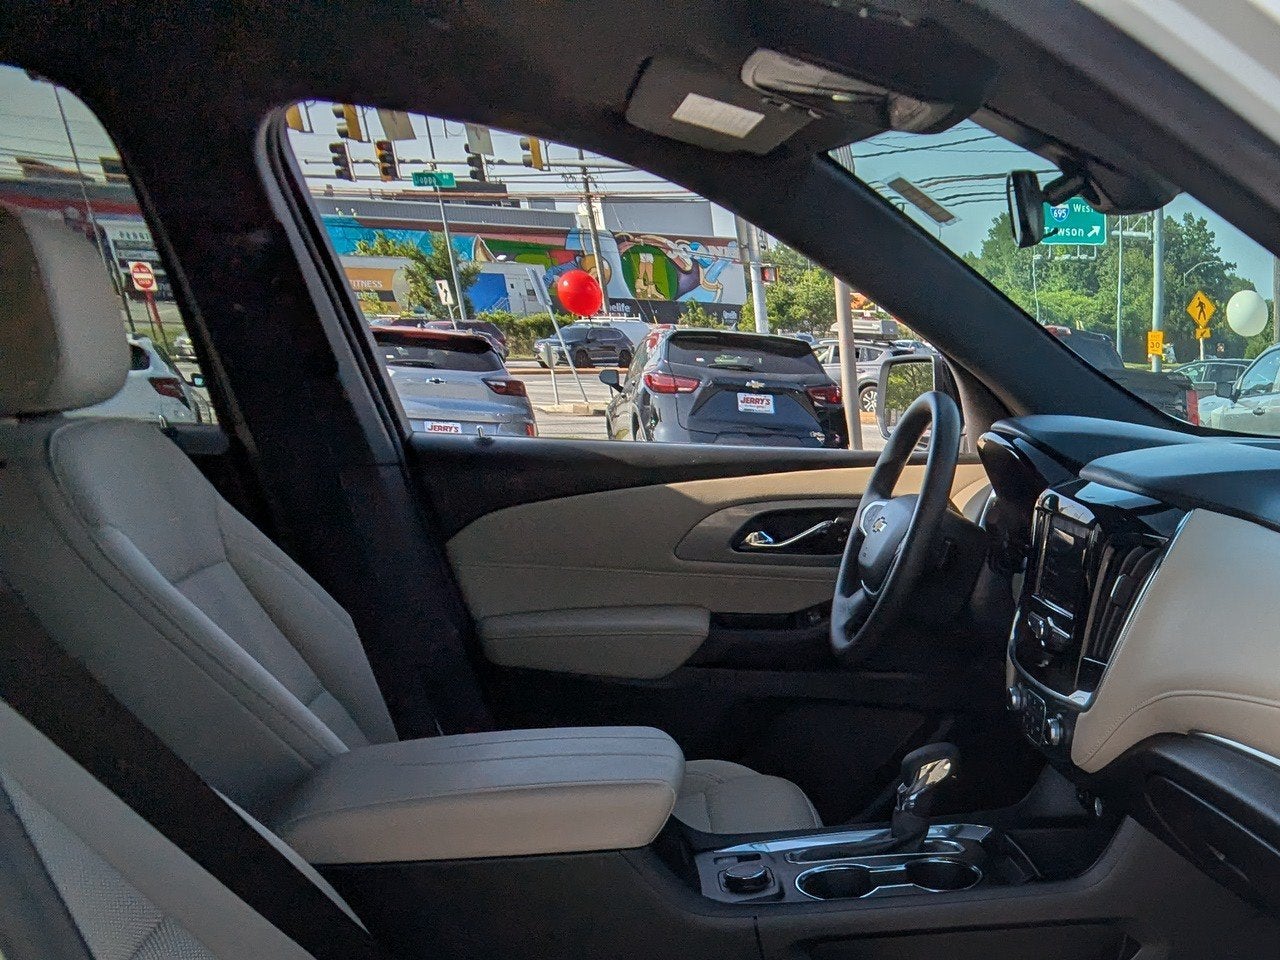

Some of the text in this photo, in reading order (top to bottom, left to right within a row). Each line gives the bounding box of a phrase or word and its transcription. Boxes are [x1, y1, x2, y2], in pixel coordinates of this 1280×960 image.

[1053, 208, 1067, 220] 695
[1149, 341, 1161, 349] 30
[740, 396, 771, 406] JERRY'S
[427, 424, 459, 433] JERRY'S
